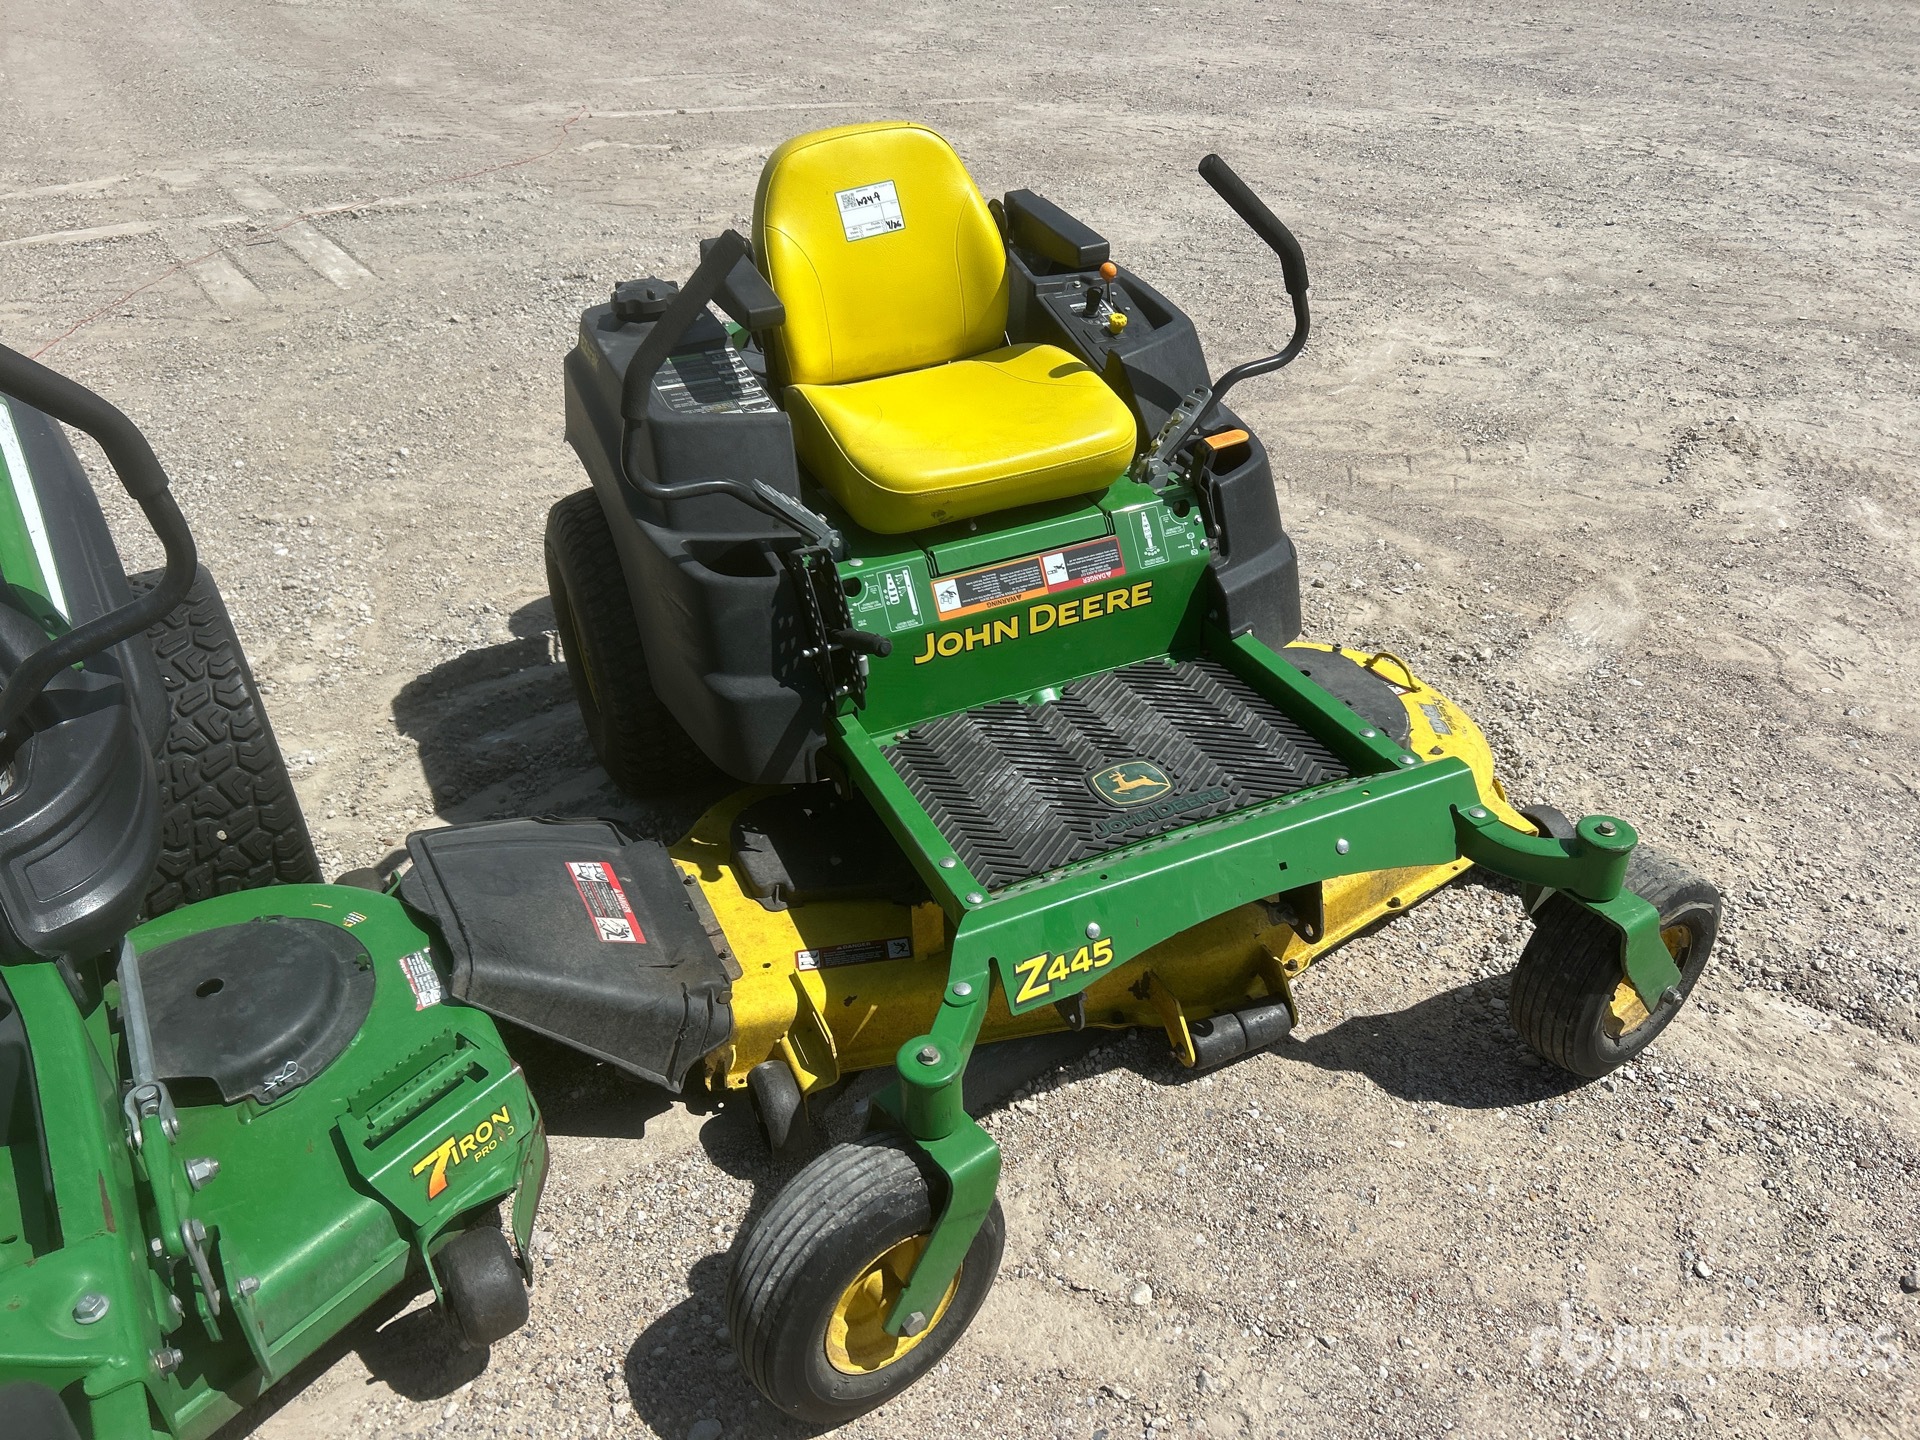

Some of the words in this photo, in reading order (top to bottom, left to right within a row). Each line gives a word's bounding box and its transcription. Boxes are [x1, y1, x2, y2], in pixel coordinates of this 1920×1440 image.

[1083, 573, 1107, 585] DANGER
[986, 597, 1018, 609] WARNING
[914, 615, 1019, 665] JOHN
[1028, 580, 1153, 635] DEERE
[1095, 807, 1156, 839] JOHN
[1153, 787, 1231, 820] DEERE
[1014, 936, 1115, 1005] Z445
[473, 1139, 498, 1163] PRO
